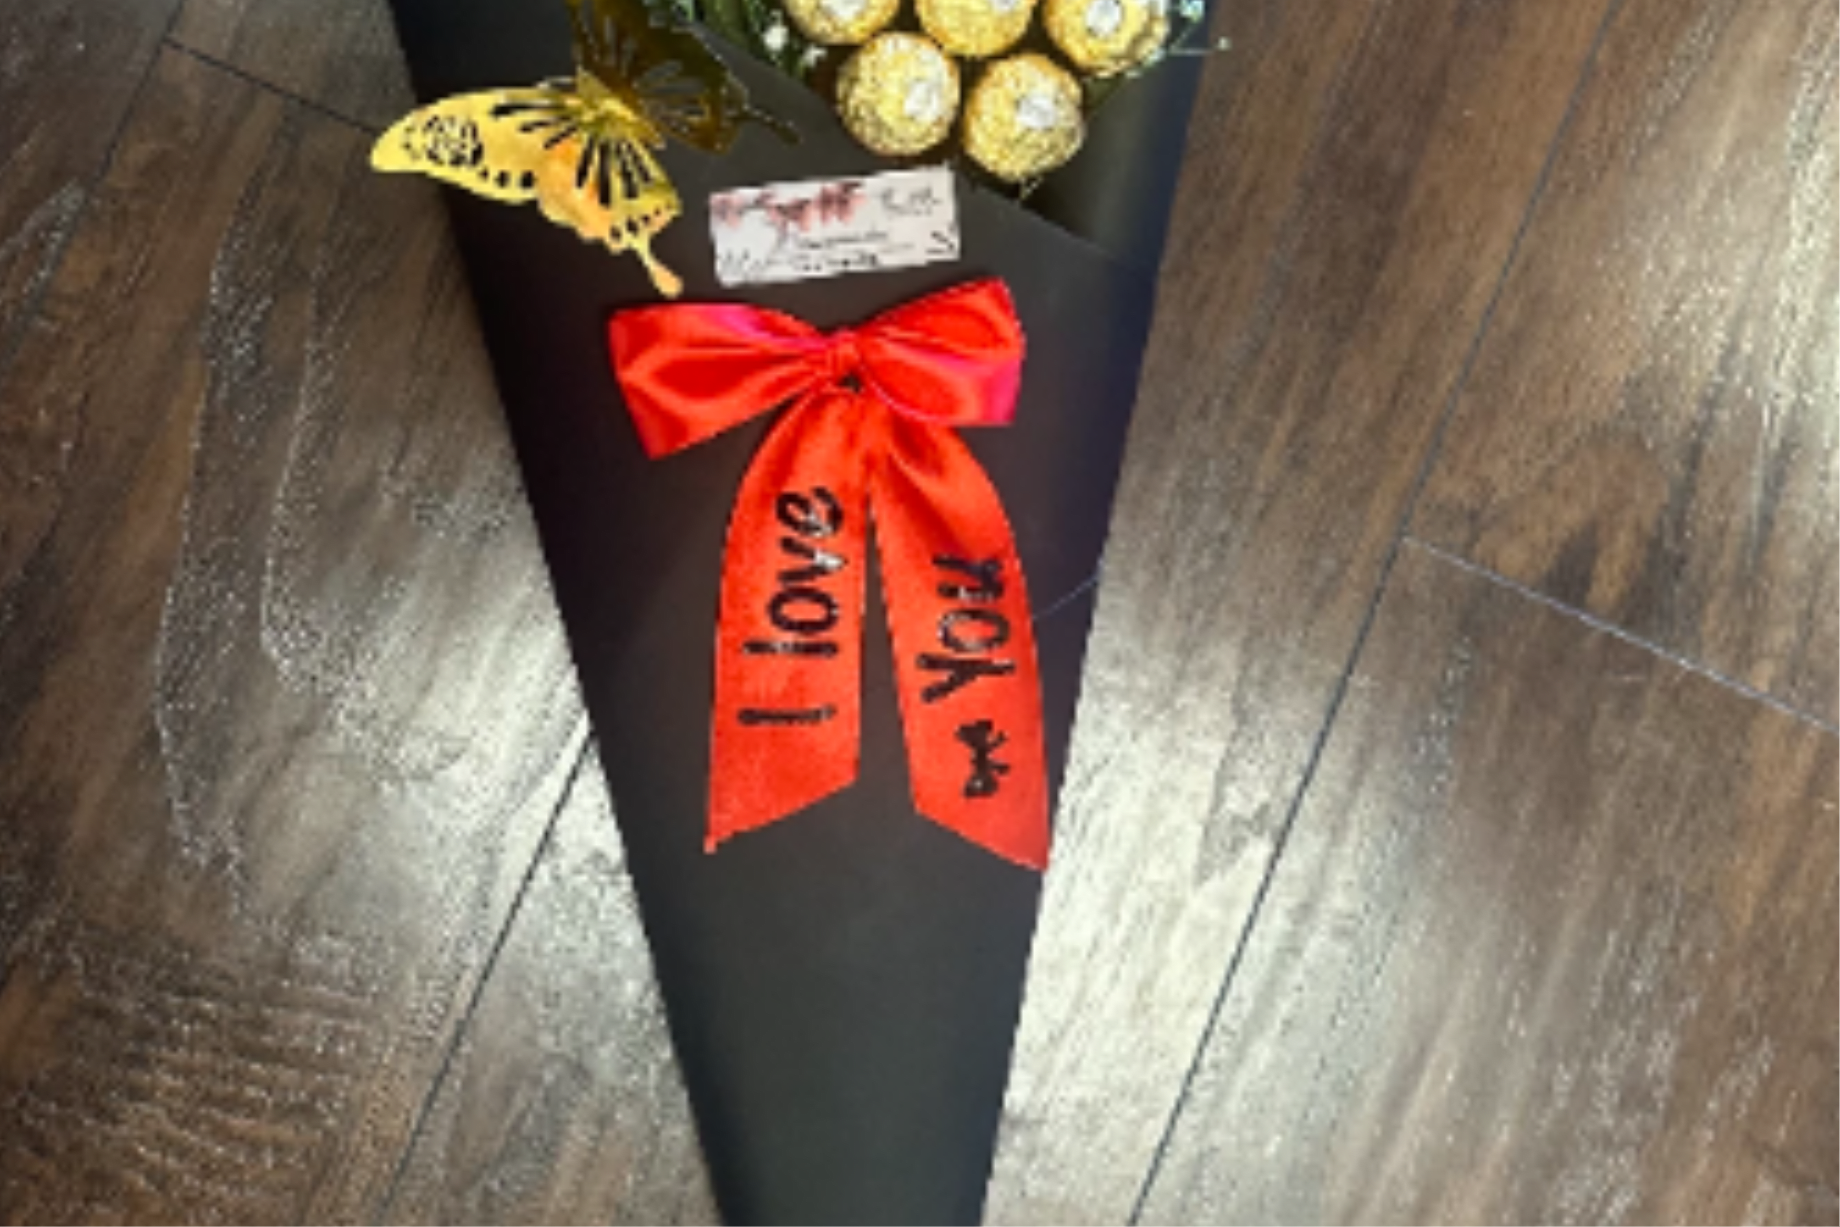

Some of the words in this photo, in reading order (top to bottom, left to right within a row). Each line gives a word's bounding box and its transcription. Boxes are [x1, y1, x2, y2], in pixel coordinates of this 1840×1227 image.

[742, 486, 847, 657] love
[915, 553, 1015, 704] You
[737, 703, 837, 726] I
